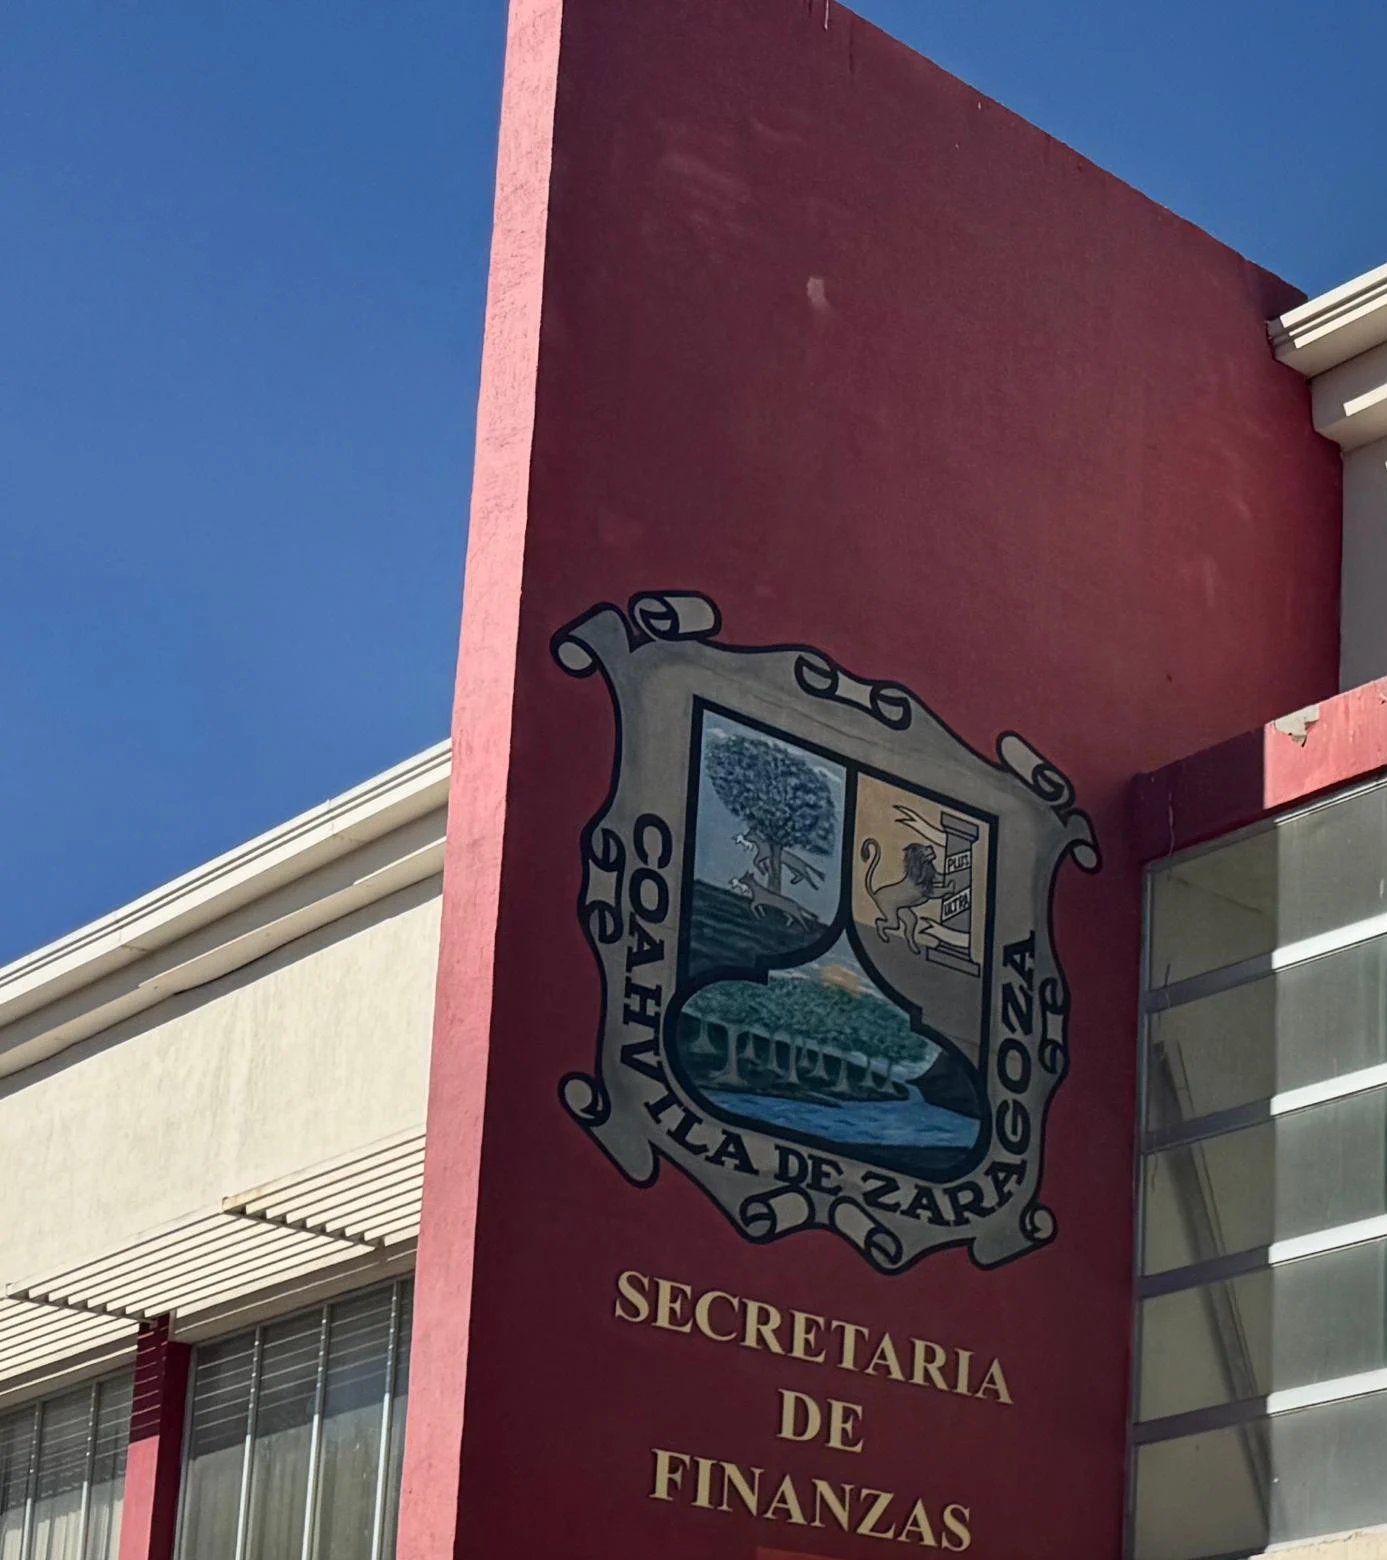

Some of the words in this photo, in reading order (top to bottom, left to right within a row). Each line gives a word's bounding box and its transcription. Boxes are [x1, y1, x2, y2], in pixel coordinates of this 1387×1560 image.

[774, 1153, 843, 1197] DE
[859, 929, 1038, 1228] ZARAGOZA
[615, 1270, 1014, 1405] SECRETARIA
[777, 1387, 864, 1453] DE
[650, 1448, 972, 1552] FINANZAS
